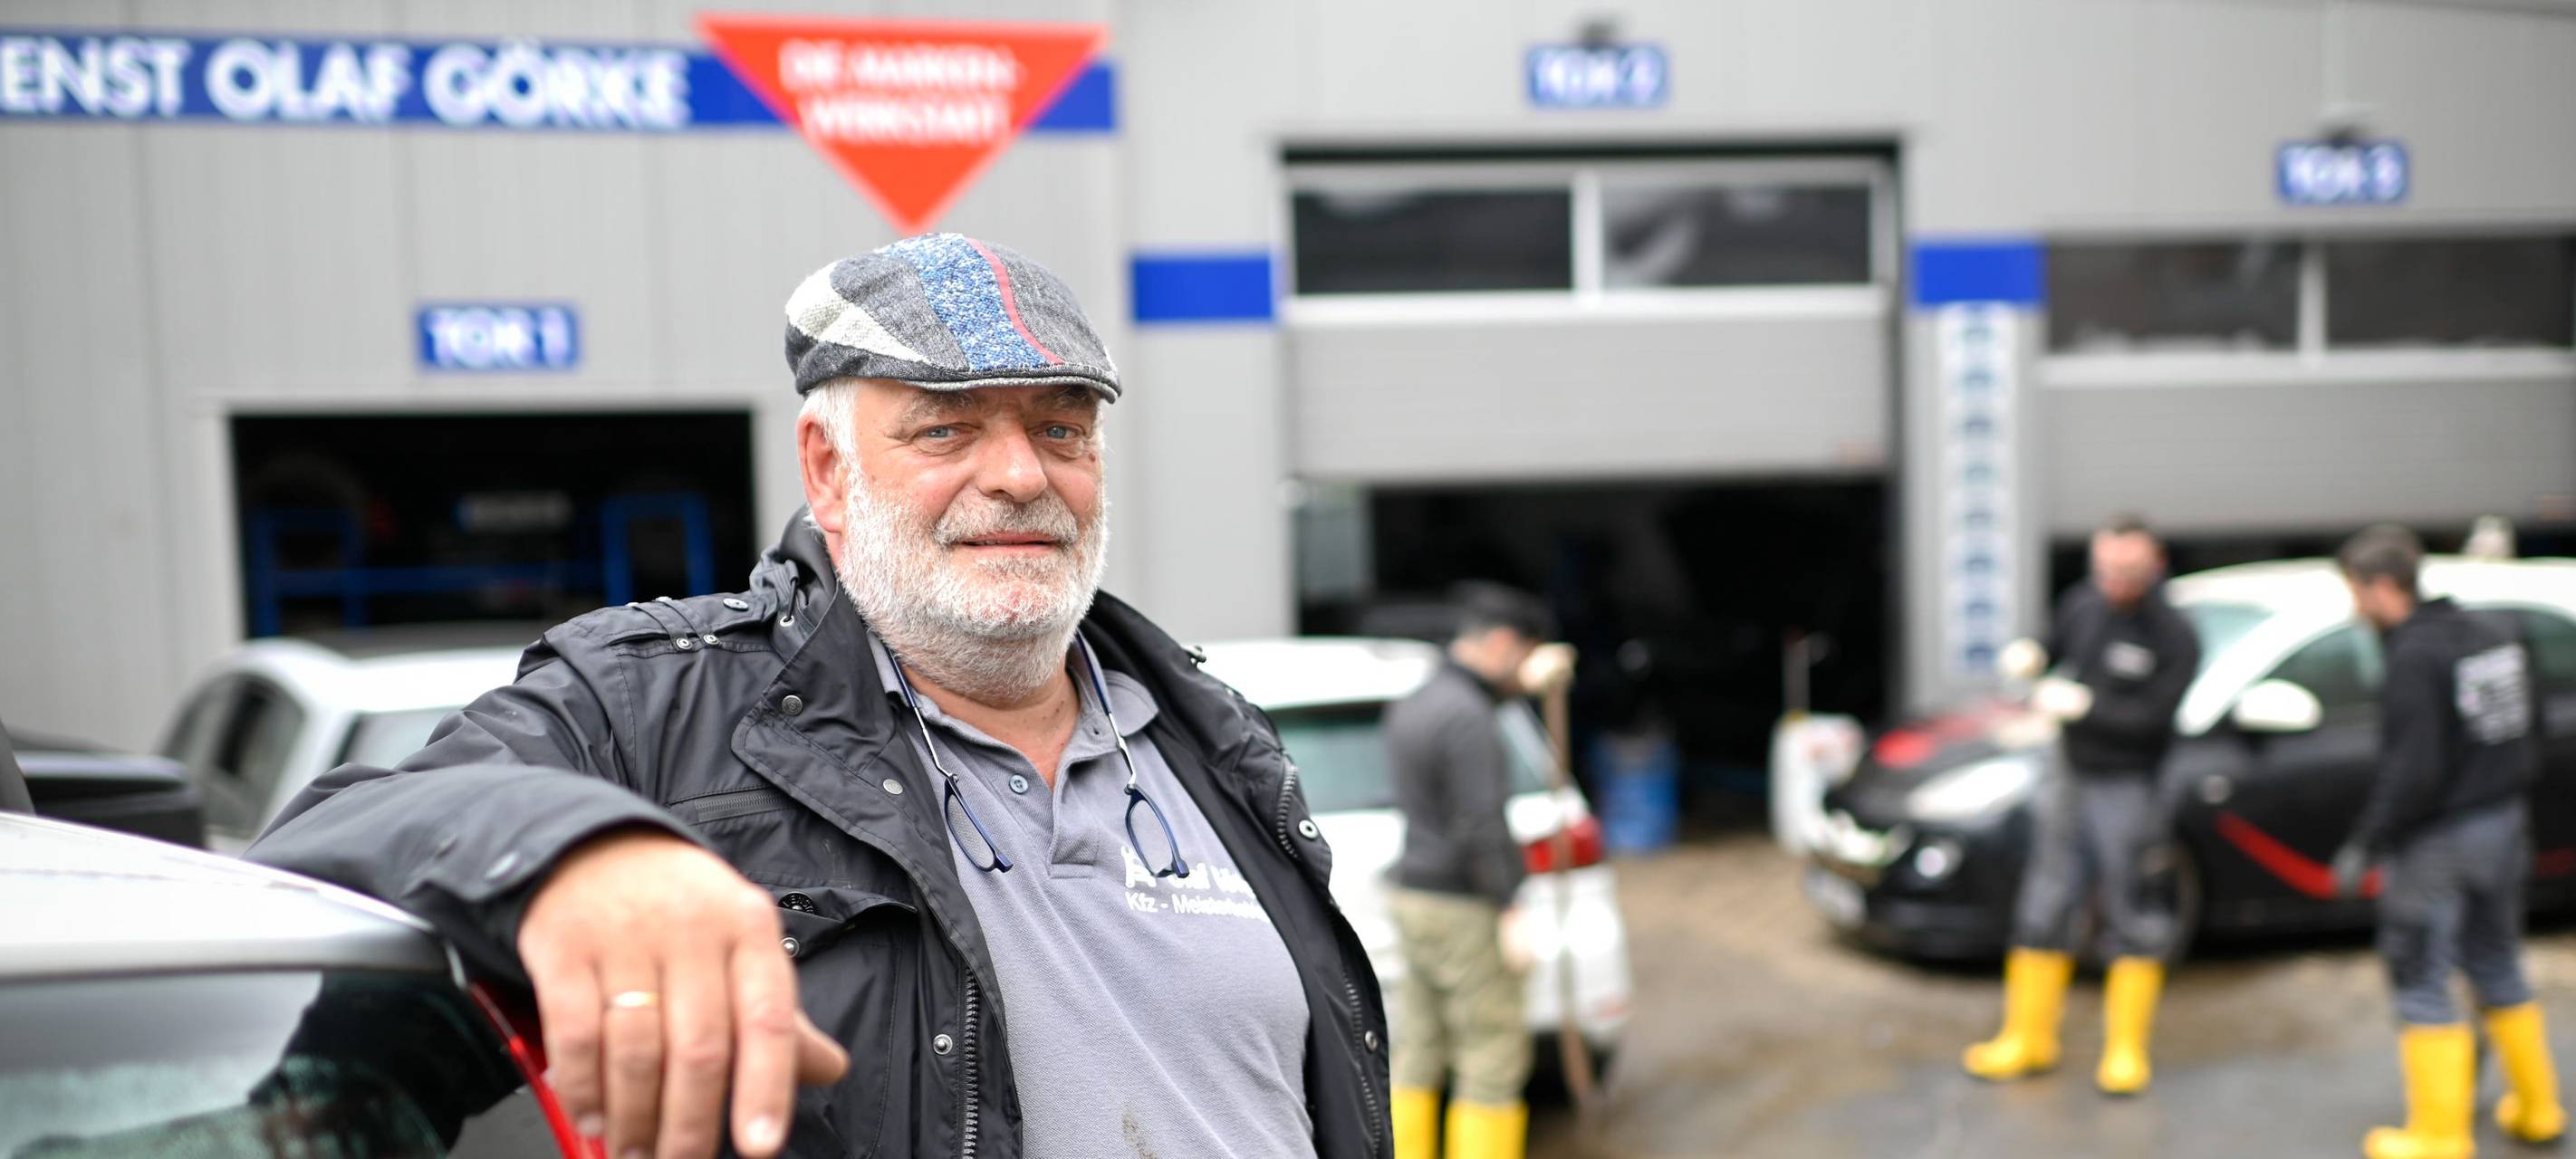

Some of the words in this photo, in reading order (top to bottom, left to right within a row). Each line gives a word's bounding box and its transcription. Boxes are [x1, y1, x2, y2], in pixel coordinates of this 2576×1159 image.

[205, 39, 409, 122] OLAF
[424, 38, 691, 126] GÖRKE
[429, 307, 538, 366] TOR
[543, 307, 568, 366] 1
[1125, 892, 1158, 913] Kfz
